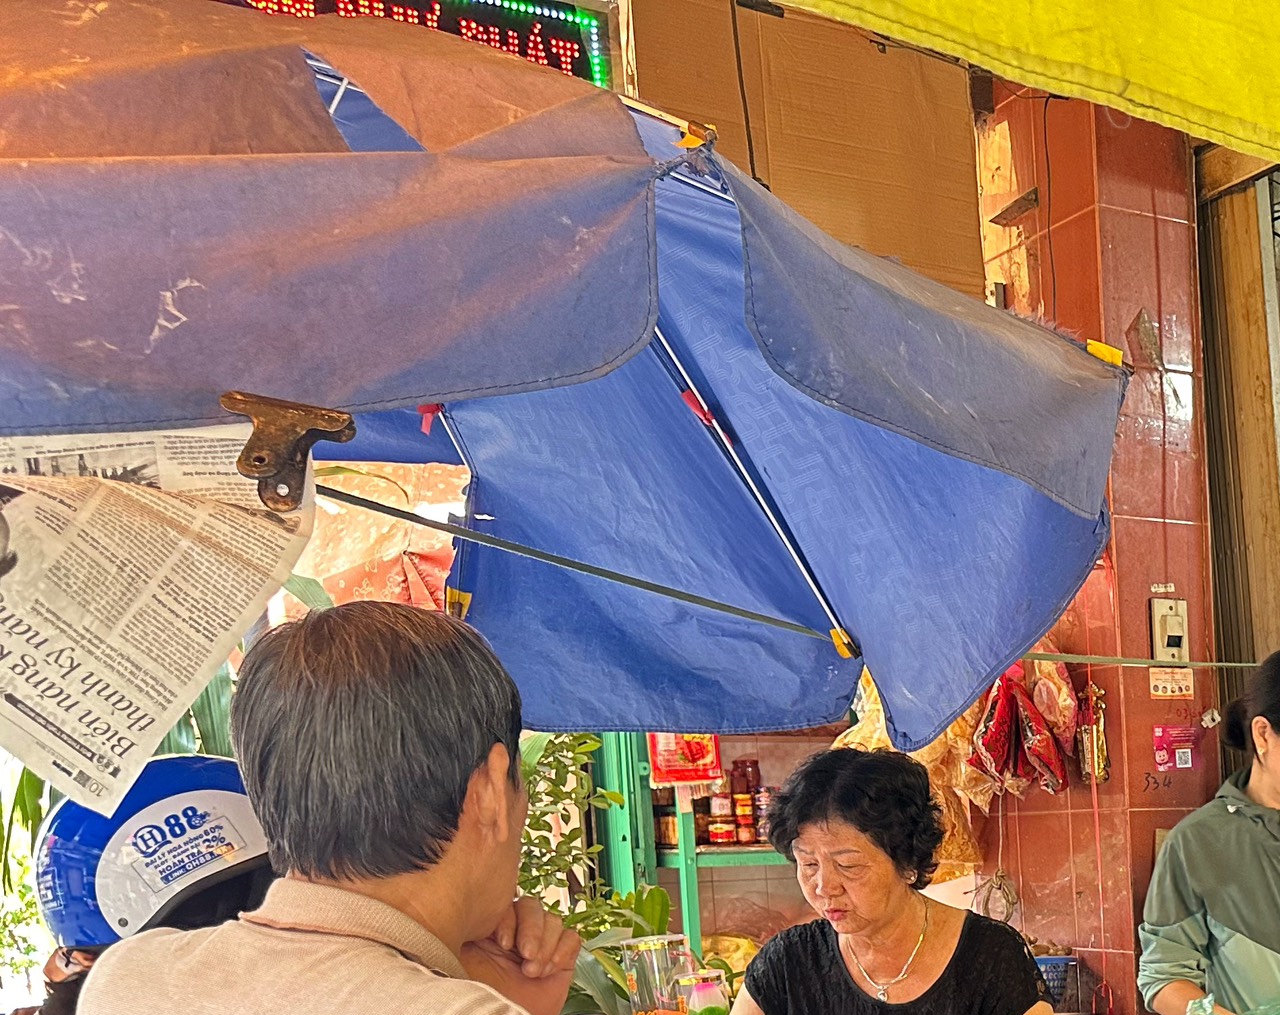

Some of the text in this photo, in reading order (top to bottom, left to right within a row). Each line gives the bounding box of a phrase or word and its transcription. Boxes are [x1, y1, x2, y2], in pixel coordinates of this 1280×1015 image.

[8, 653, 81, 714] năng
[46, 646, 82, 681] kỹ
[80, 670, 156, 732] thành
[78, 709, 138, 759] Biến
